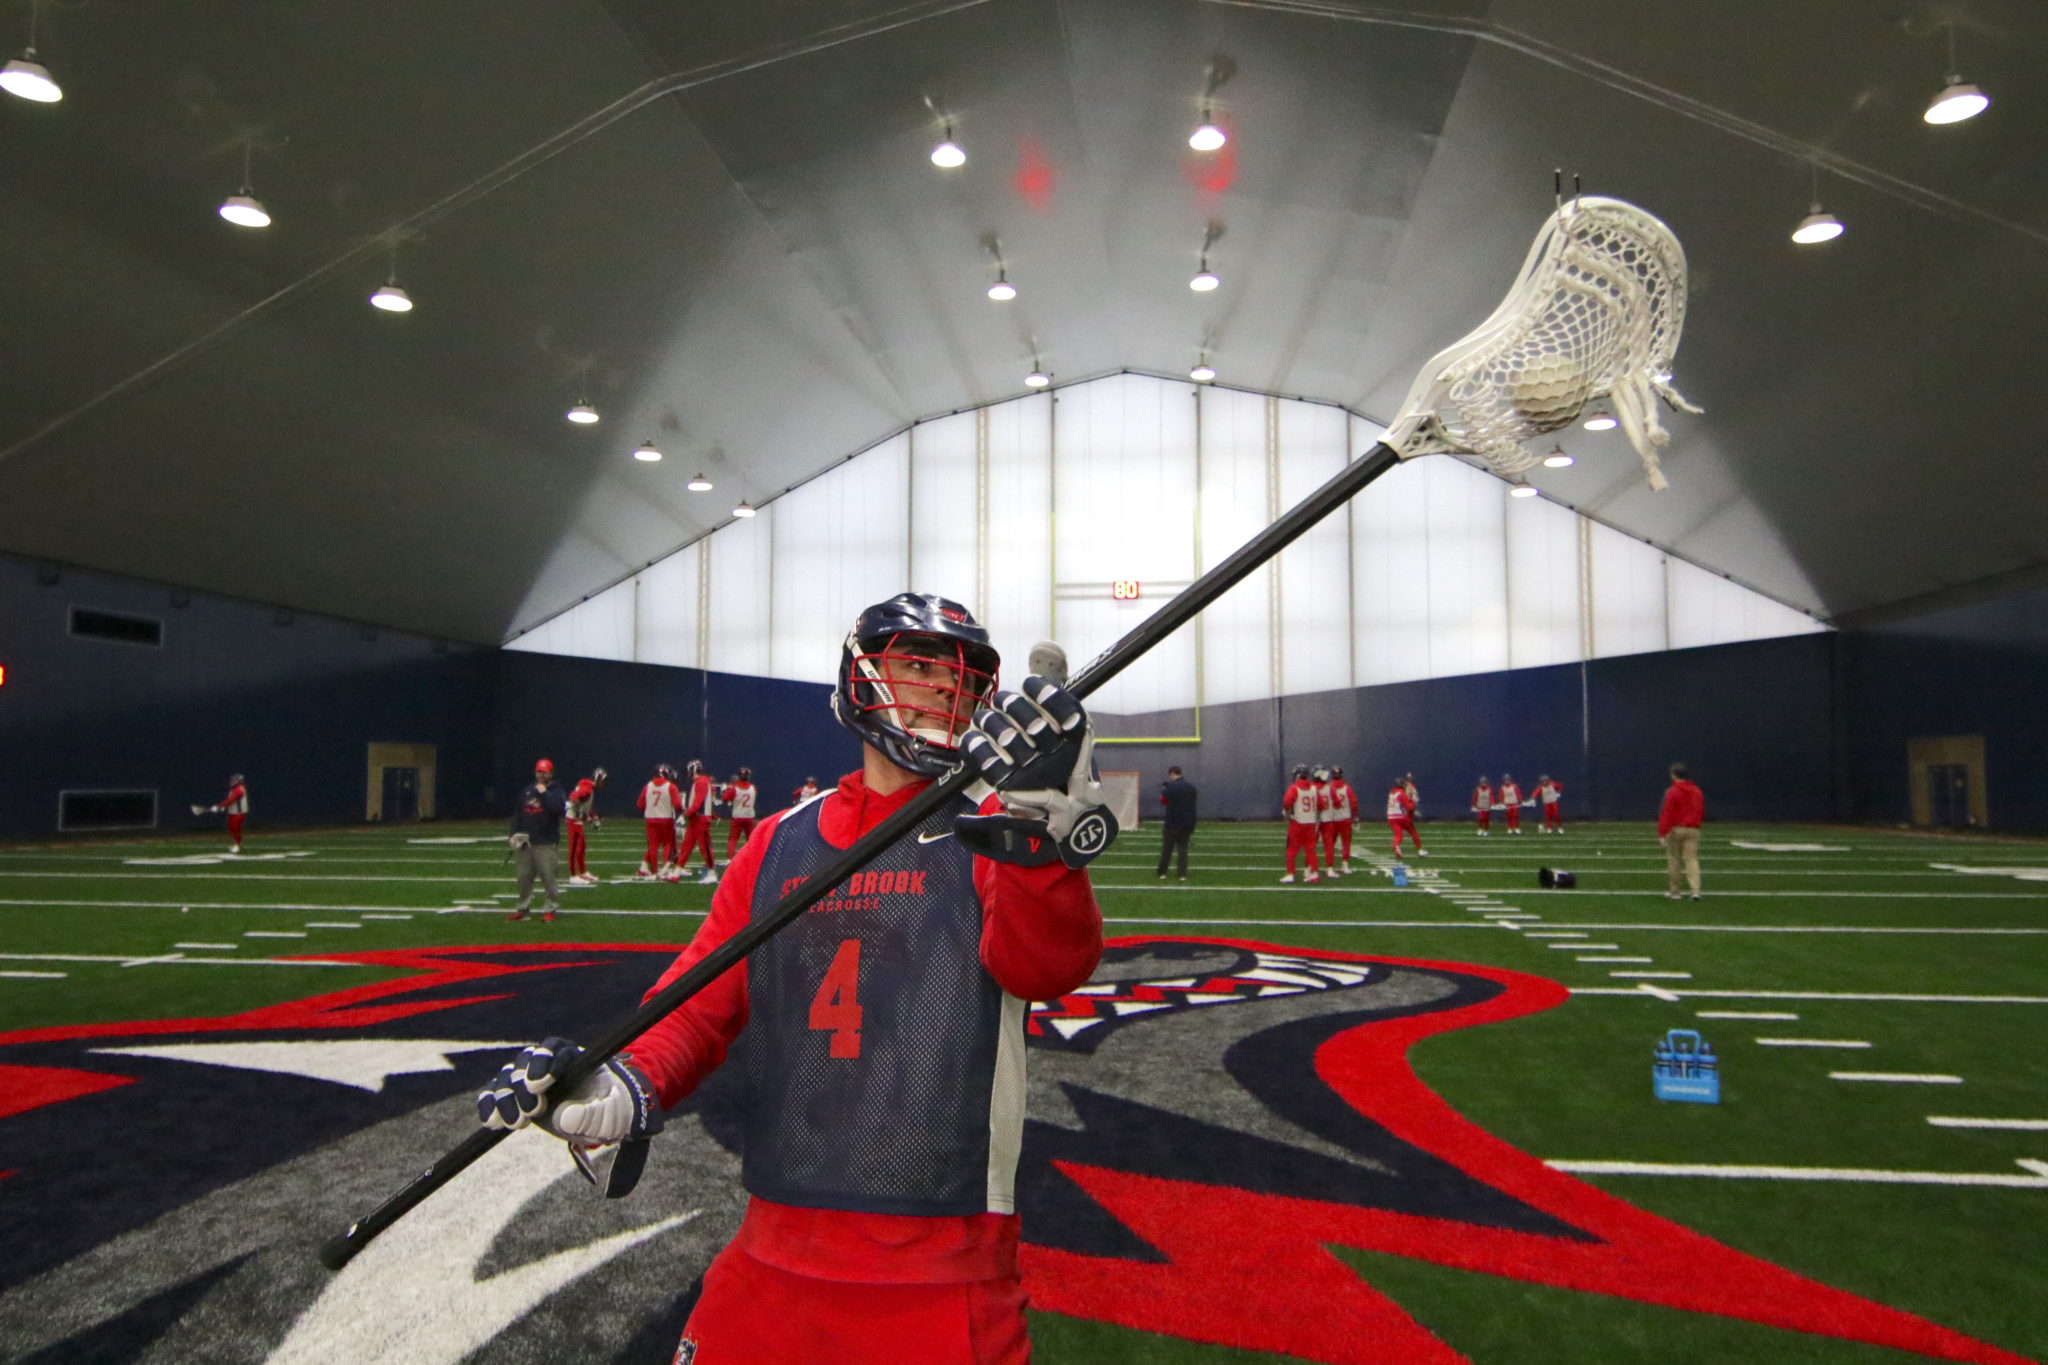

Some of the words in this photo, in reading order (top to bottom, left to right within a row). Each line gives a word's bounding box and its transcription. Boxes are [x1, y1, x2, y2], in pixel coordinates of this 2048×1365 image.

[848, 871, 928, 896] BROOK
[809, 897, 881, 913] LACROSSE
[808, 938, 864, 1060] 4
